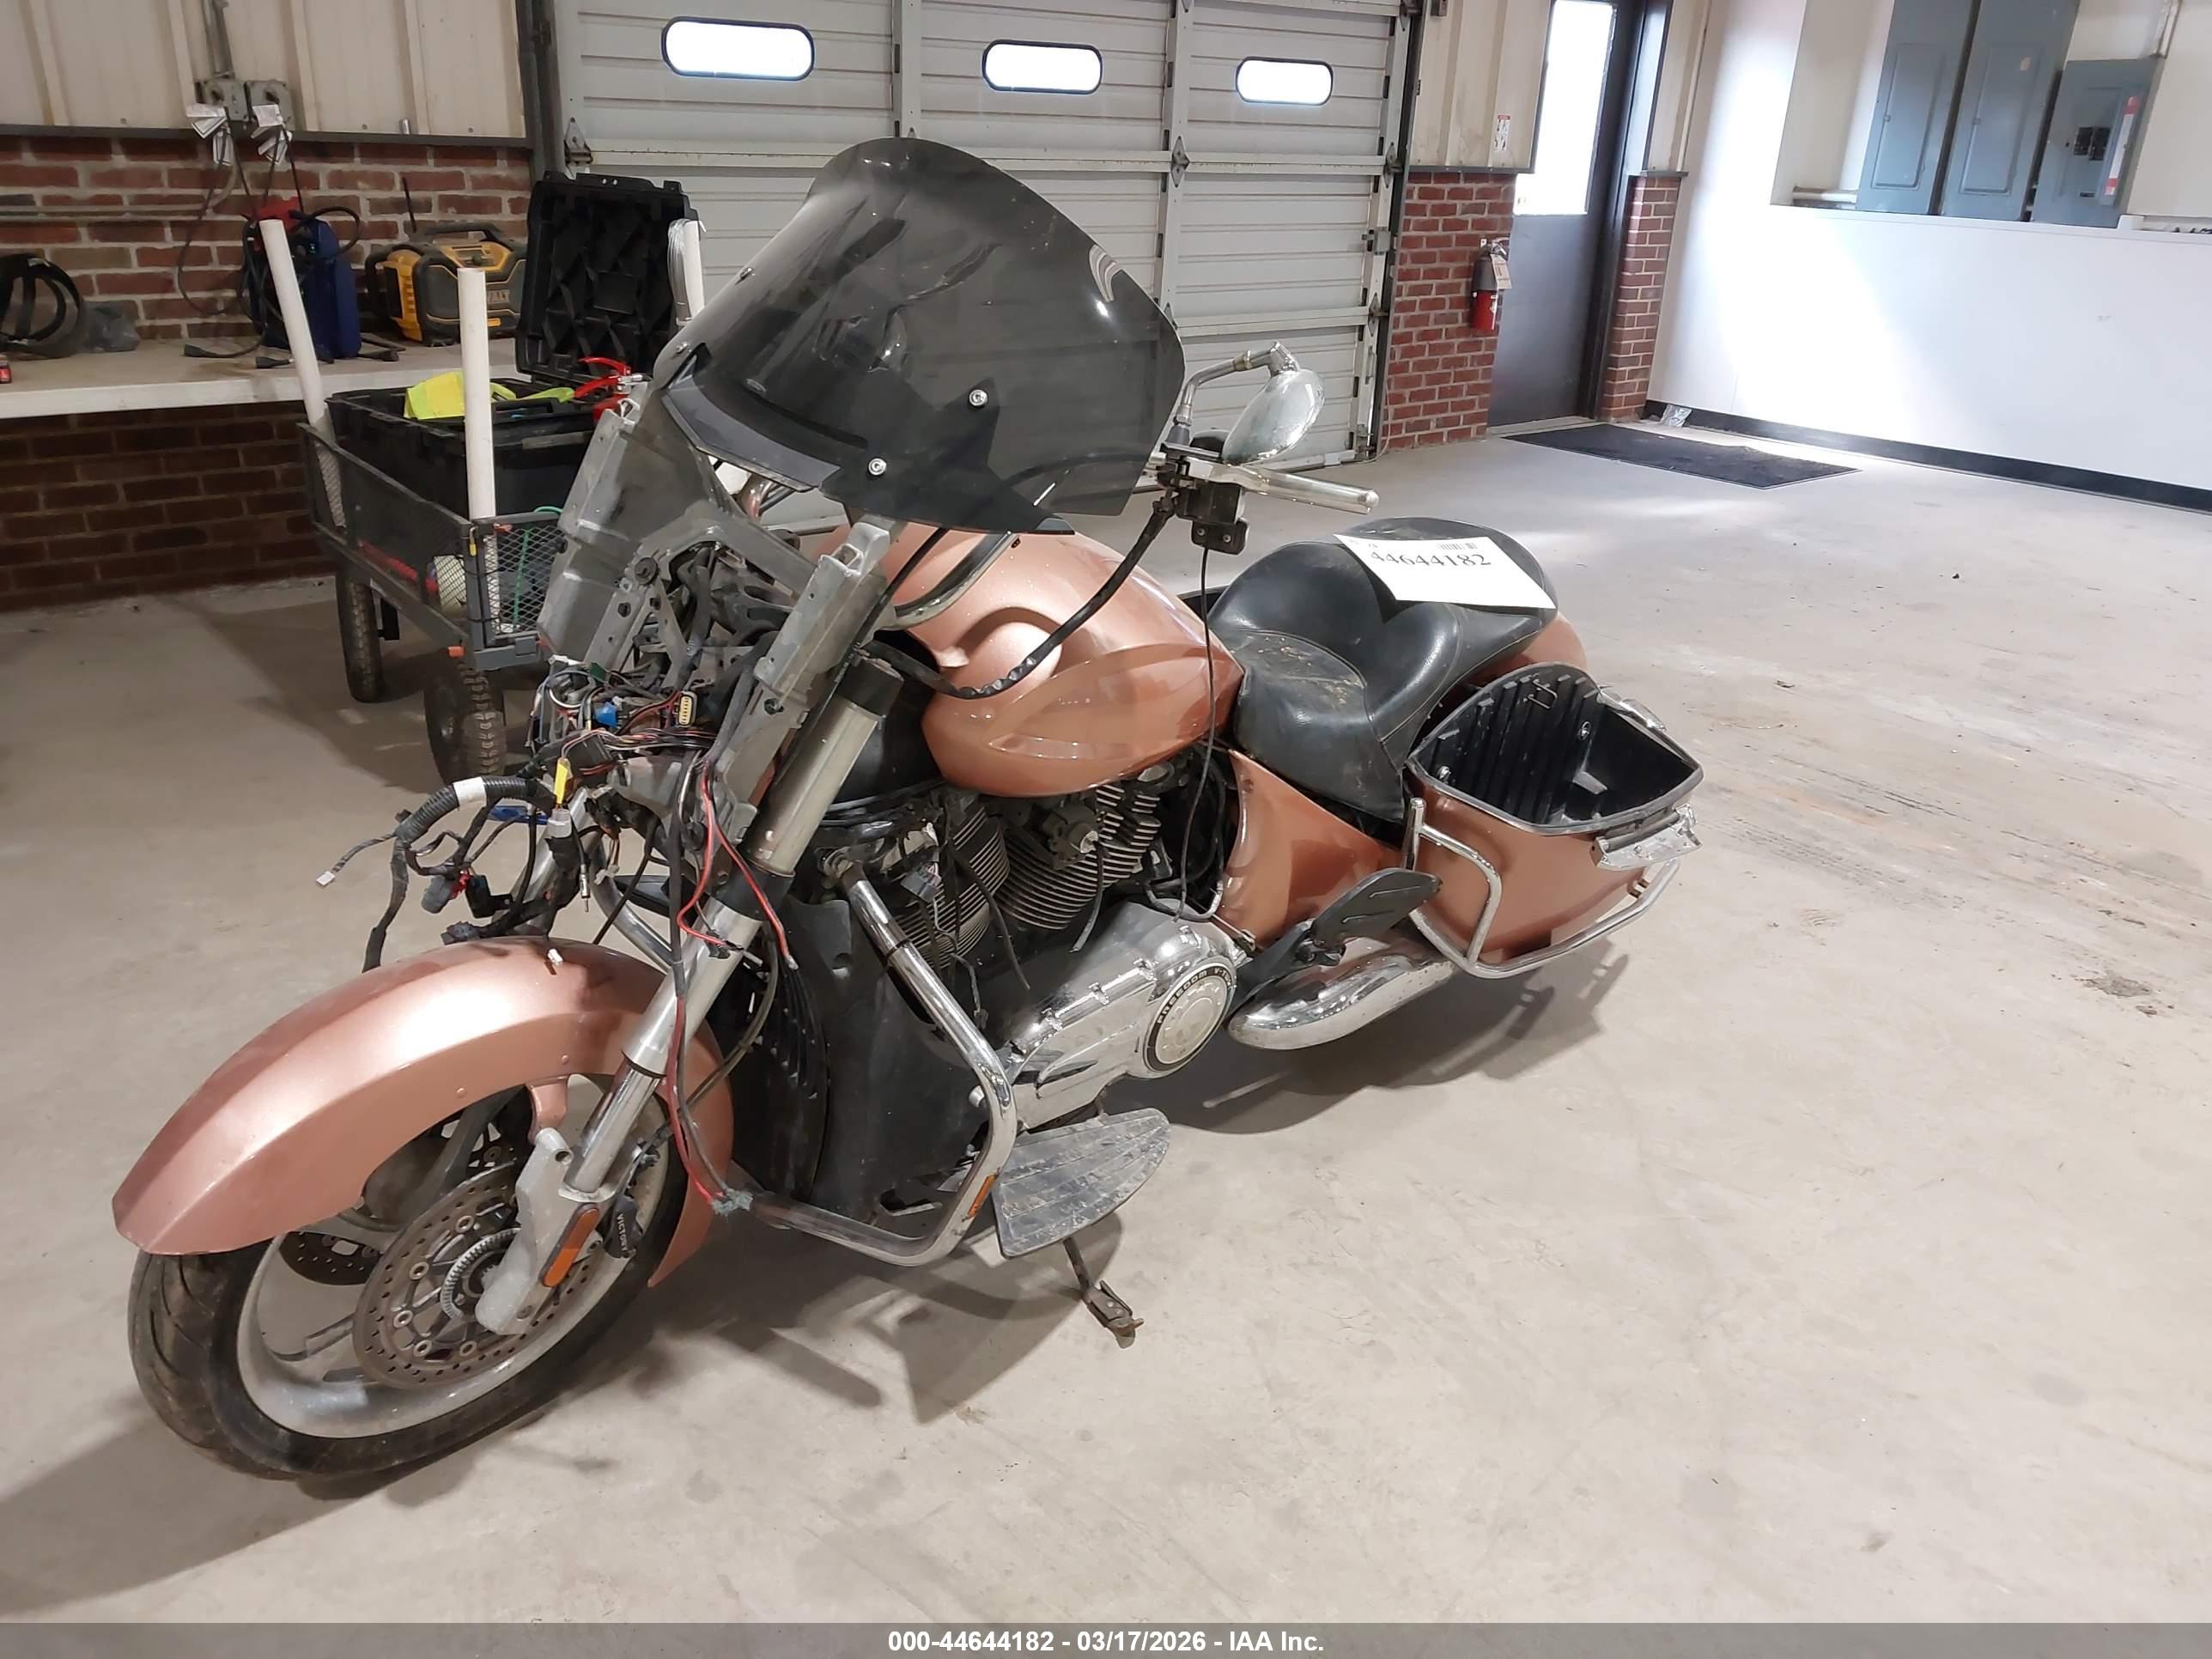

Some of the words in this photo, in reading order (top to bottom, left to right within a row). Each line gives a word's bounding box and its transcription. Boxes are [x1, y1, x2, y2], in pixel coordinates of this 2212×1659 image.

[1370, 550, 1492, 566] 44644182
[1156, 969, 1207, 1024] FREEDOM
[617, 1212, 628, 1251] VICTORY
